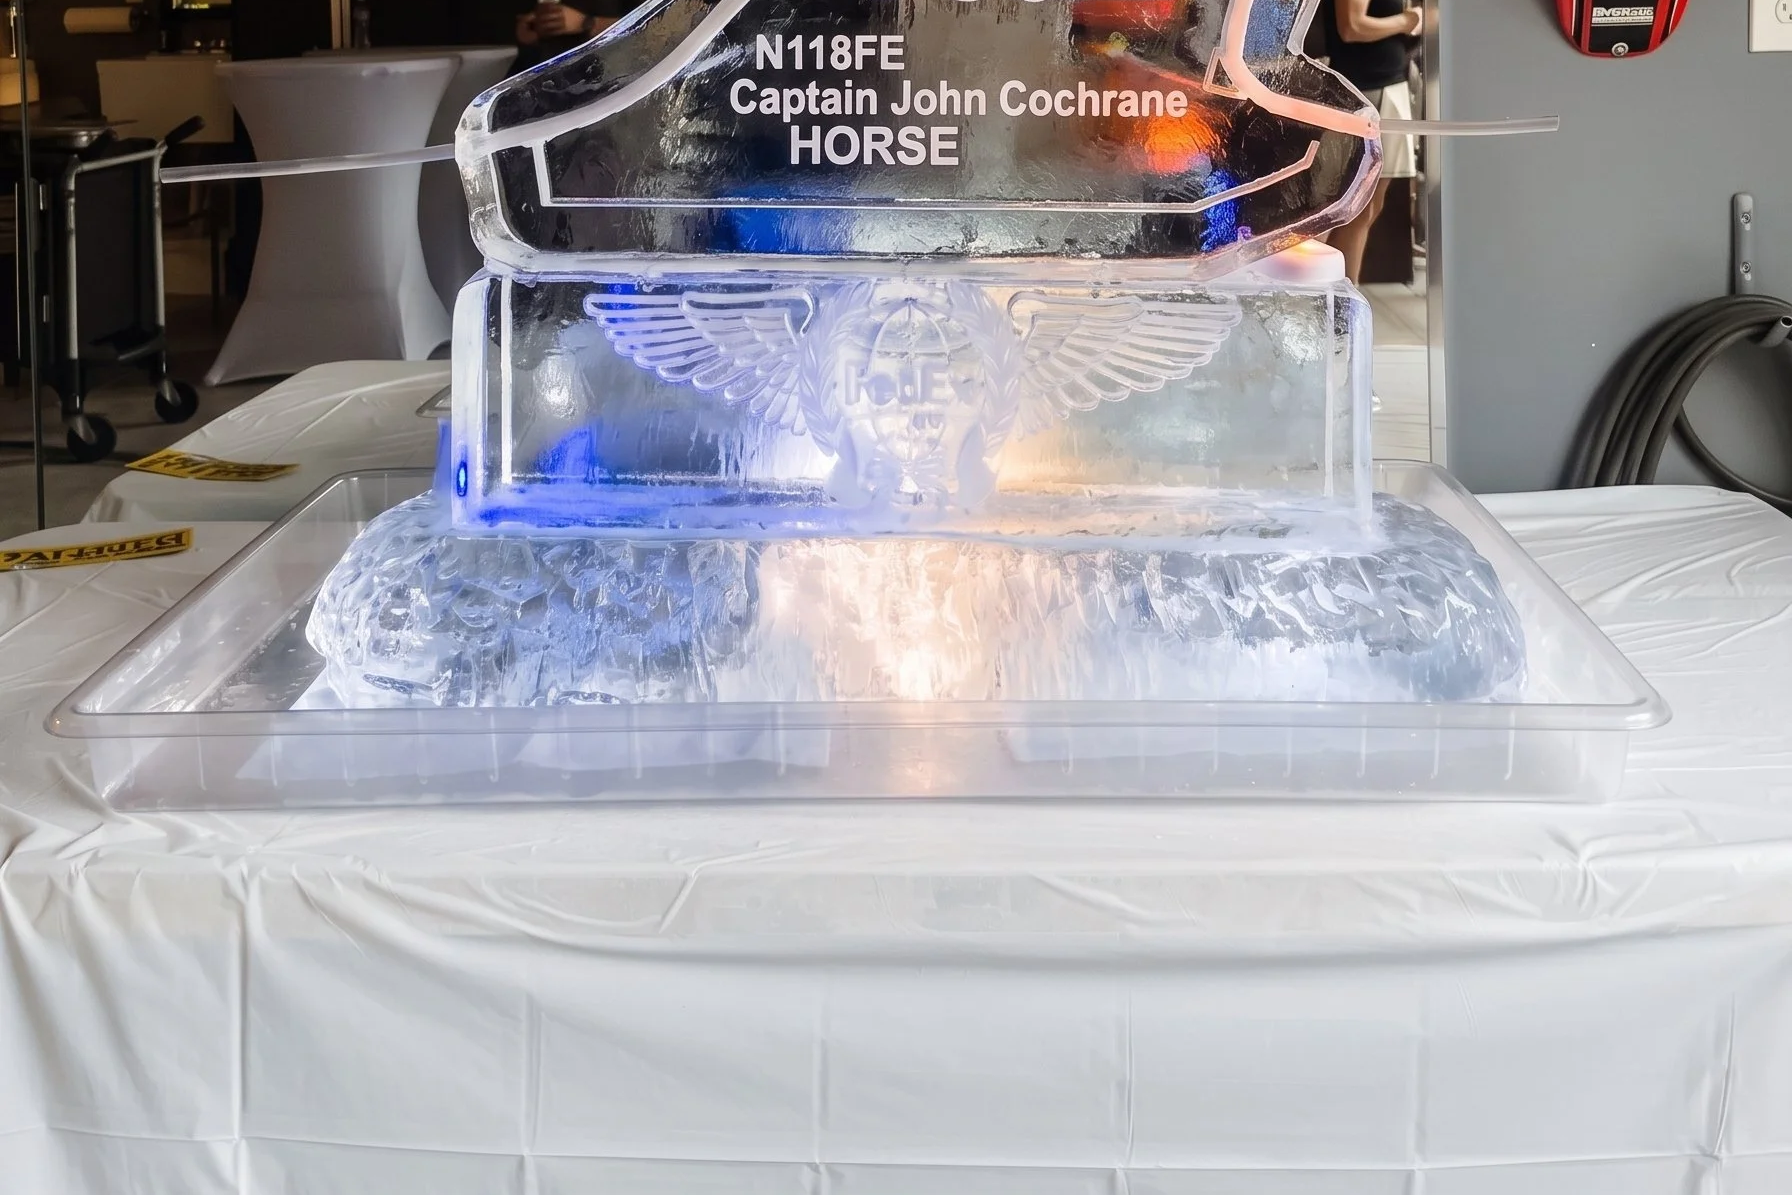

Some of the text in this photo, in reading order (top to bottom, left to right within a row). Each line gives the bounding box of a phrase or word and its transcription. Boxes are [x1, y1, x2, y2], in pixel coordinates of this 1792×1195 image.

[755, 34, 906, 71] N118FE
[729, 78, 1189, 122] Captain John Cochrane
[790, 125, 960, 166] HORSE
